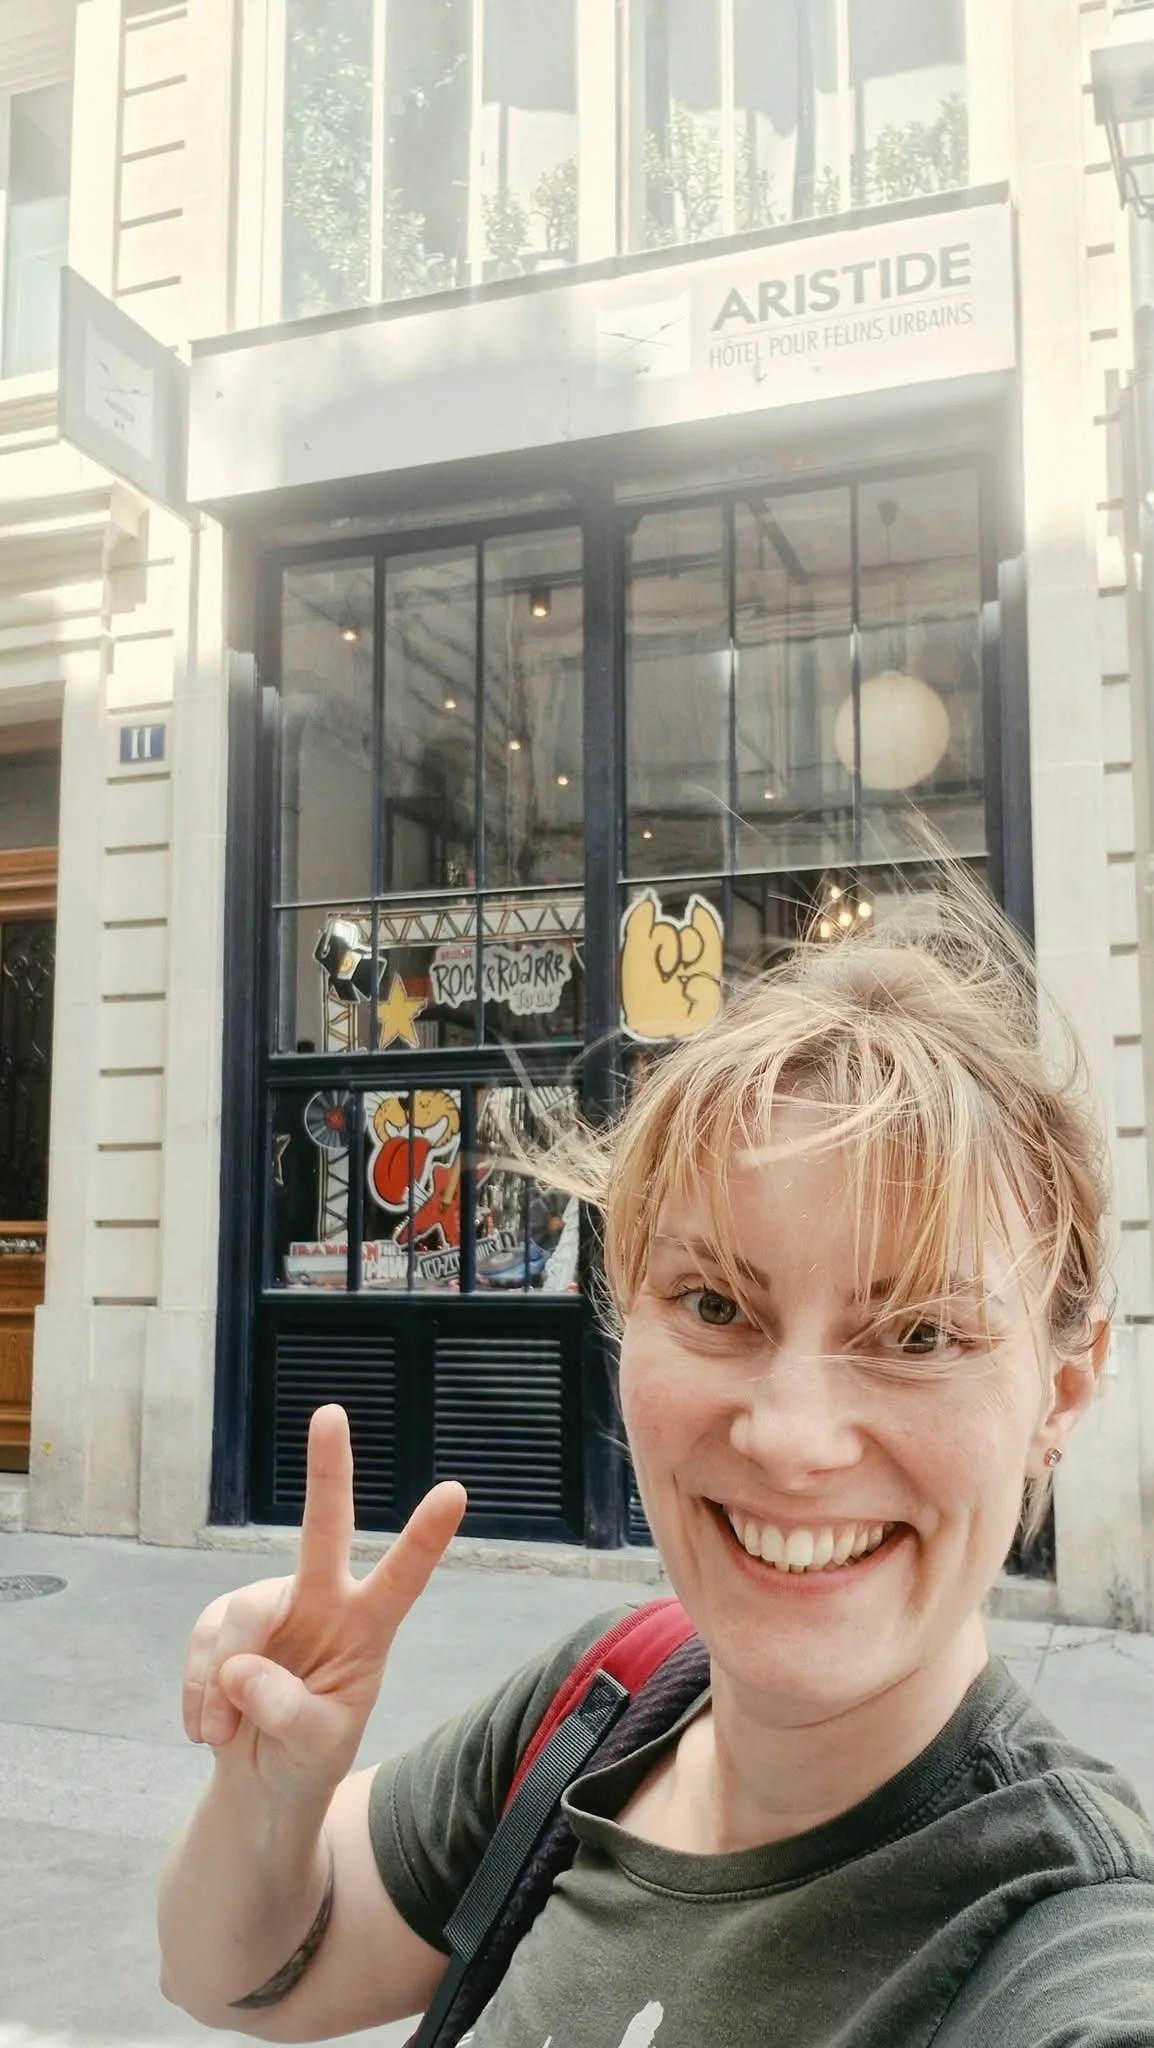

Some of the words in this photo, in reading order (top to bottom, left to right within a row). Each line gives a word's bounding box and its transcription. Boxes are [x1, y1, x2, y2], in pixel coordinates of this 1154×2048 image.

[711, 243, 971, 332] ARISTIDE
[709, 342, 761, 370] HÔTEL
[769, 329, 819, 359] POUR
[889, 302, 973, 337] URBAINS
[131, 727, 152, 760] 11
